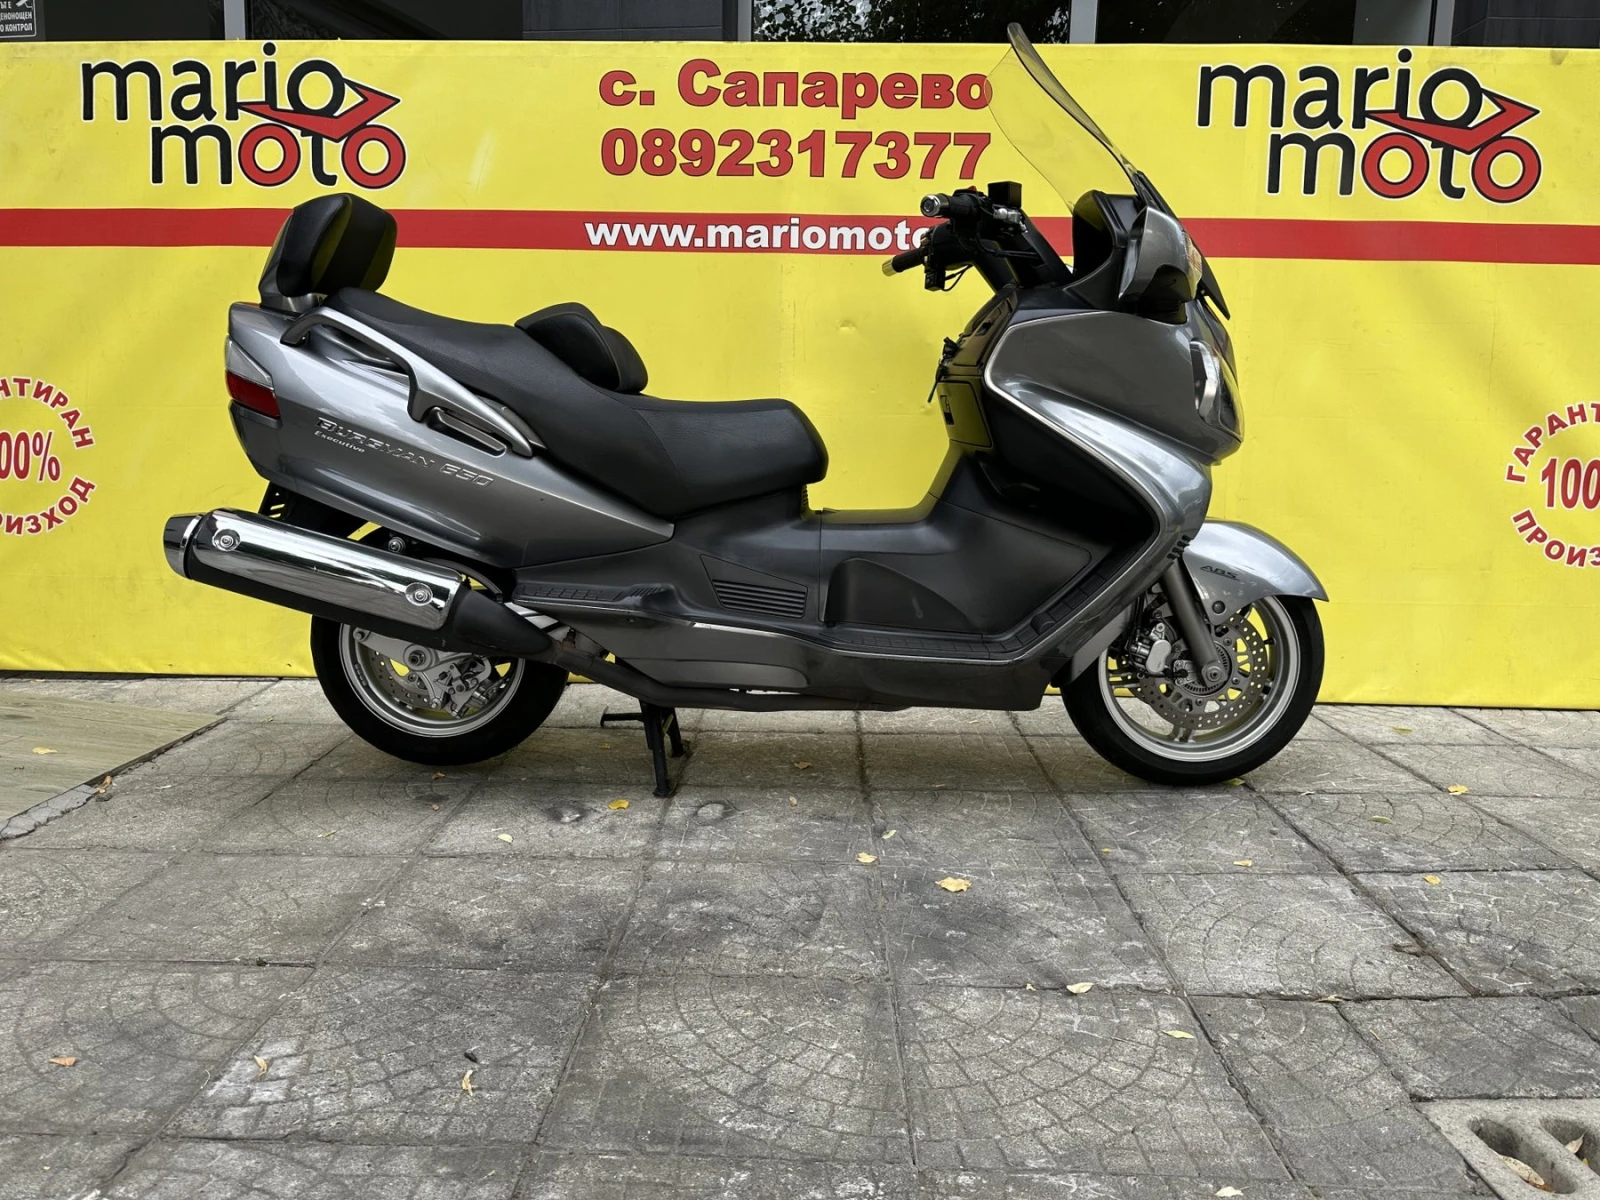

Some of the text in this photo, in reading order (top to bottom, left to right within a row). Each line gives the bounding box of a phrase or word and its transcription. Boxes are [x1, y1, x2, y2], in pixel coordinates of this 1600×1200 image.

[5, 23, 33, 32] КОНТРОЛ
[81, 41, 346, 121] mario
[677, 58, 993, 120] Сапарево
[1197, 48, 1483, 130] mario
[151, 124, 406, 189] moto
[600, 128, 992, 180] 0892317377
[1267, 132, 1542, 204] moto
[313, 430, 366, 453] Executive
[316, 417, 495, 487] BURGMAN 650
[0, 476, 96, 535] ИЗХОД
[1200, 565, 1239, 582] ABS
